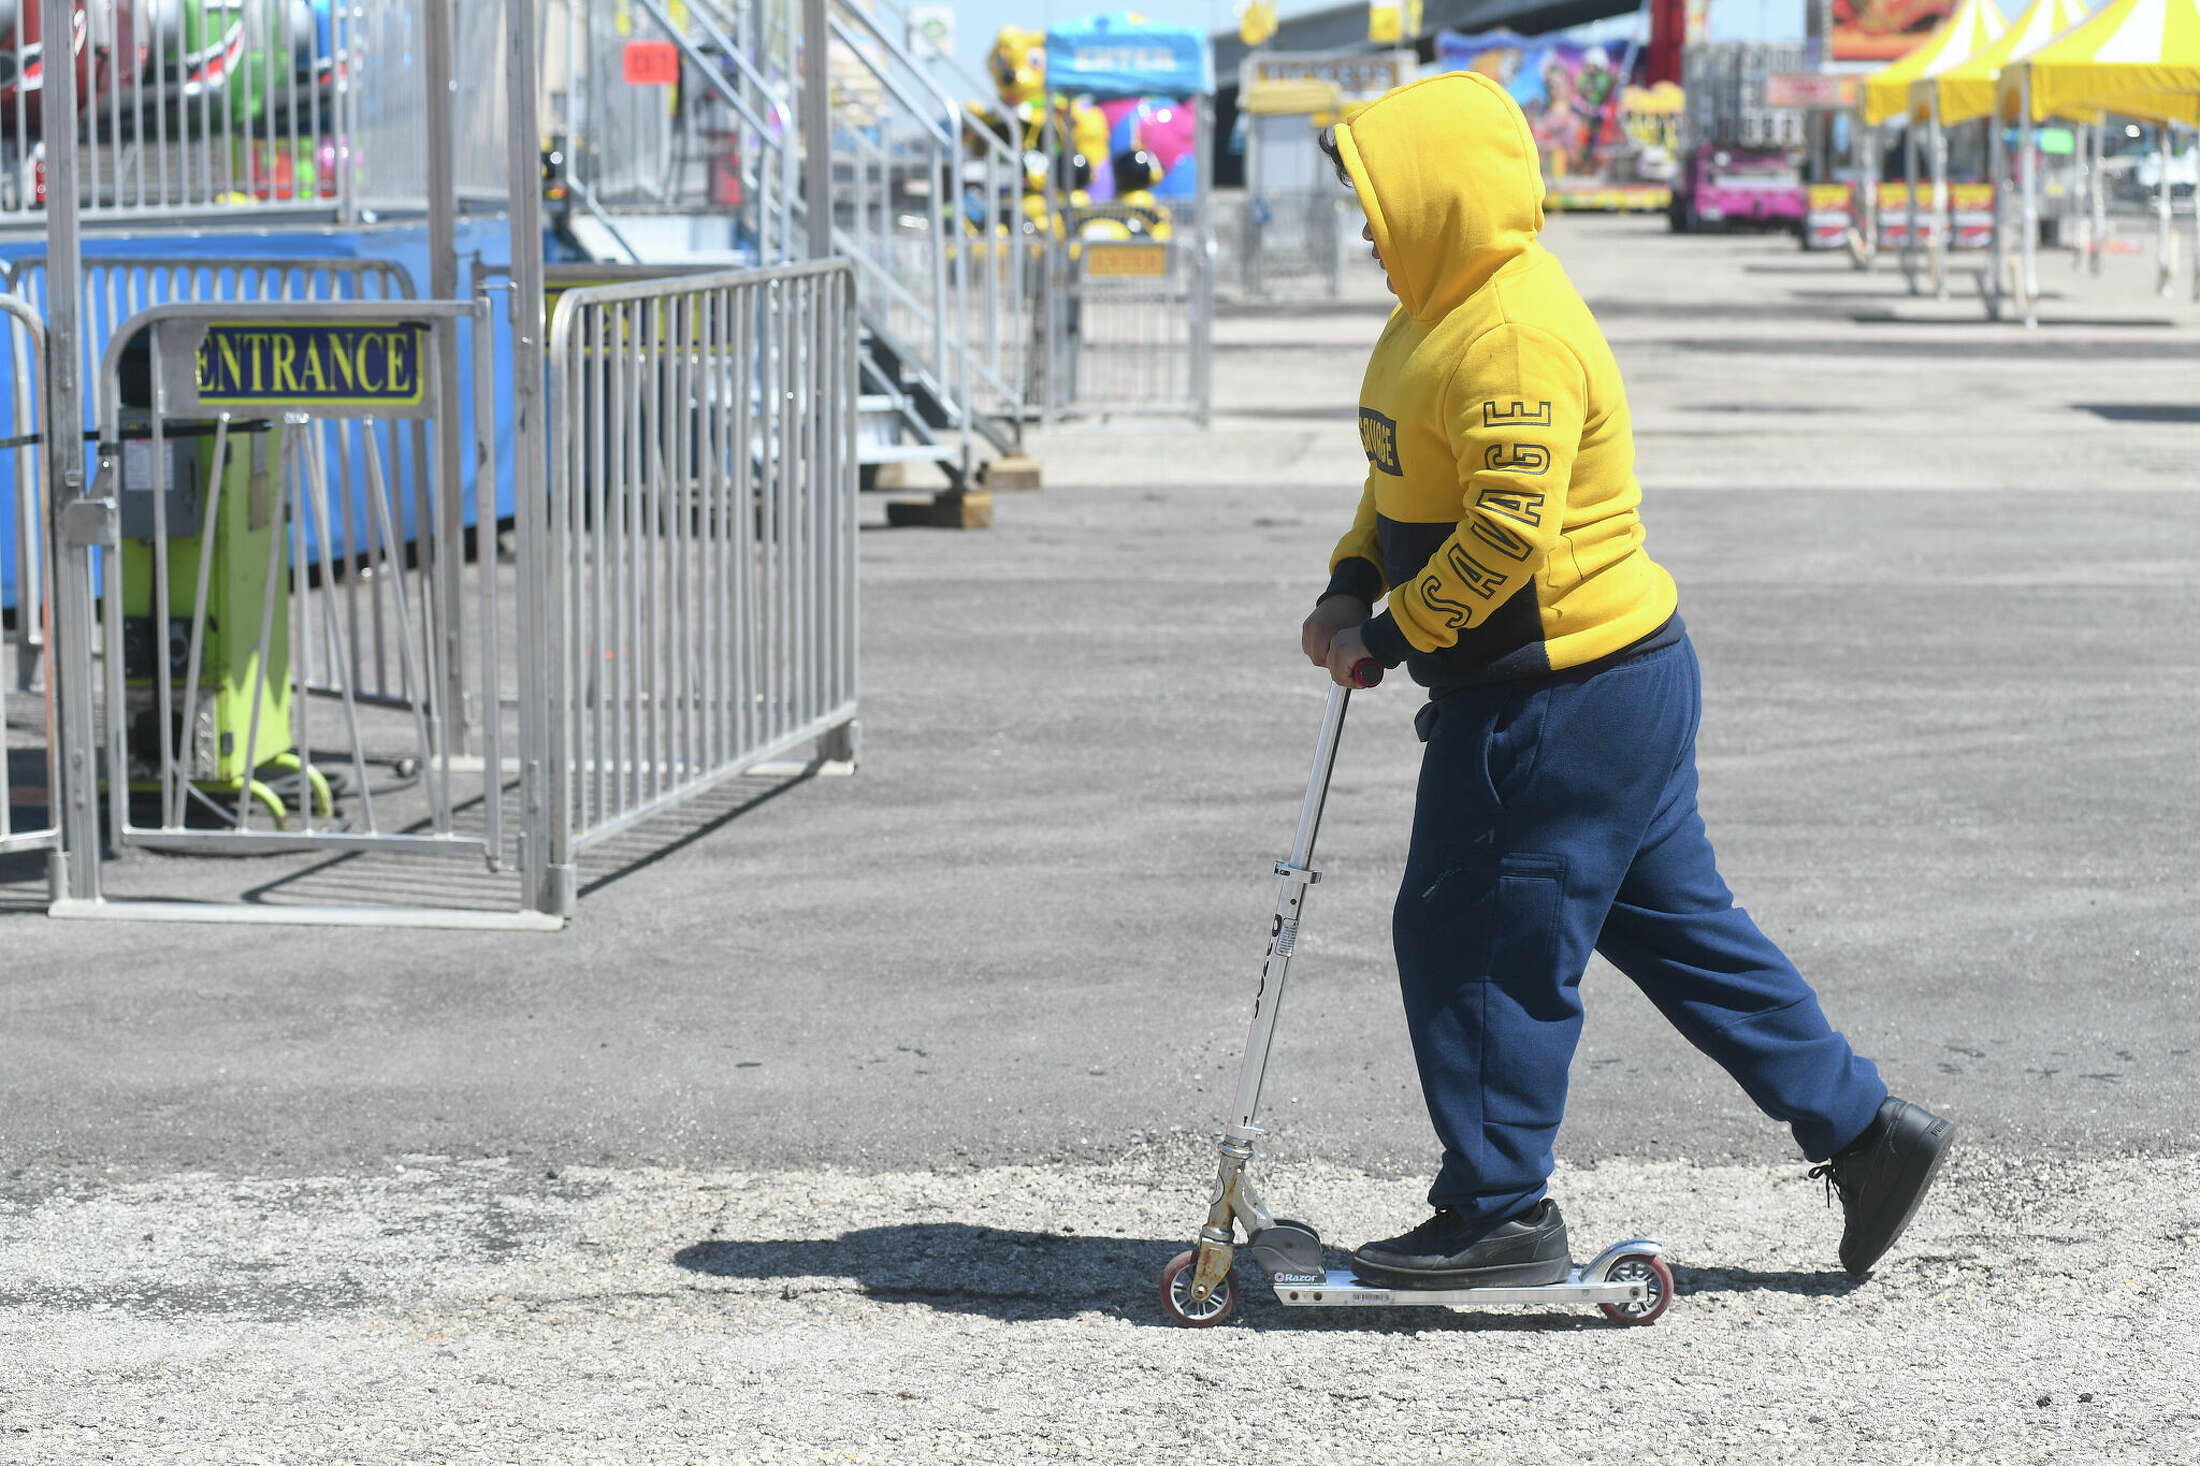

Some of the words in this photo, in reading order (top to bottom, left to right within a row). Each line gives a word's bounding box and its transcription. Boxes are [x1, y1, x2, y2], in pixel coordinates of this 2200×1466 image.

[195, 332, 411, 392] ENTRANCE
[1421, 401, 1551, 629] SAVAGE
[1284, 1272, 1318, 1283] Razor
